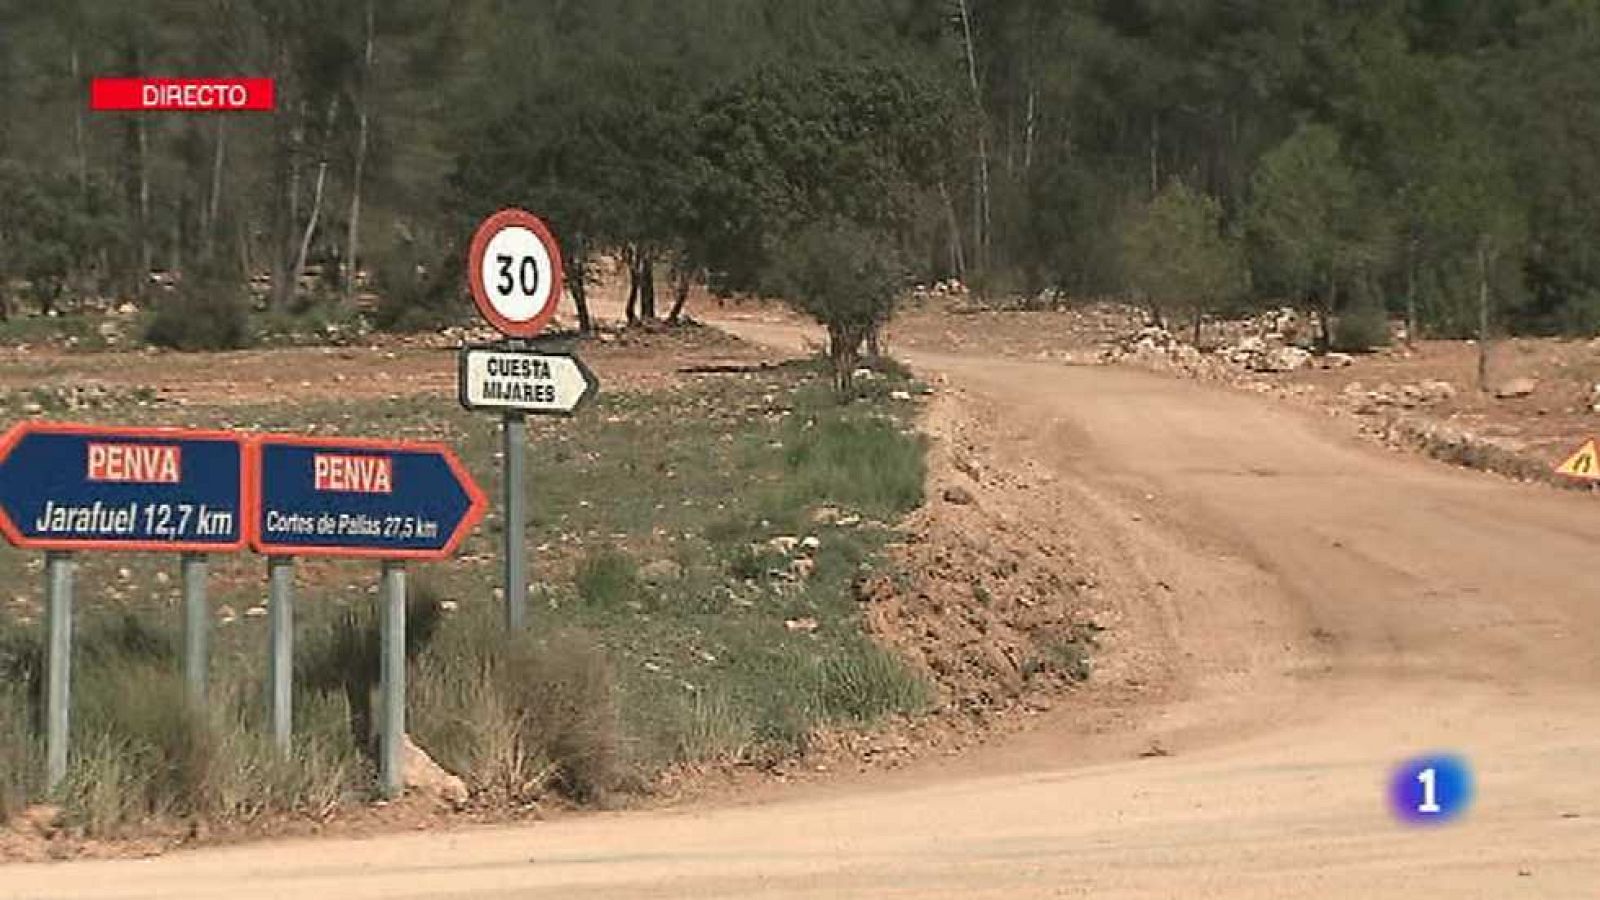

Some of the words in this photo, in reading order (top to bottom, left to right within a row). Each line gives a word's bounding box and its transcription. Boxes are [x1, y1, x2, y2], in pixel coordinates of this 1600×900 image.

[496, 254, 538, 296] 30
[487, 358, 551, 379] CUESTA
[483, 382, 555, 402] MIJARES
[88, 443, 179, 481] PENVA
[315, 455, 392, 492] PENVA
[36, 501, 137, 533] Jarafuel
[143, 503, 192, 540] 12,7
[196, 504, 232, 535] km
[267, 511, 313, 534] Cortes
[317, 513, 335, 534] de
[383, 517, 413, 538] 27,5
[416, 515, 438, 538] km
